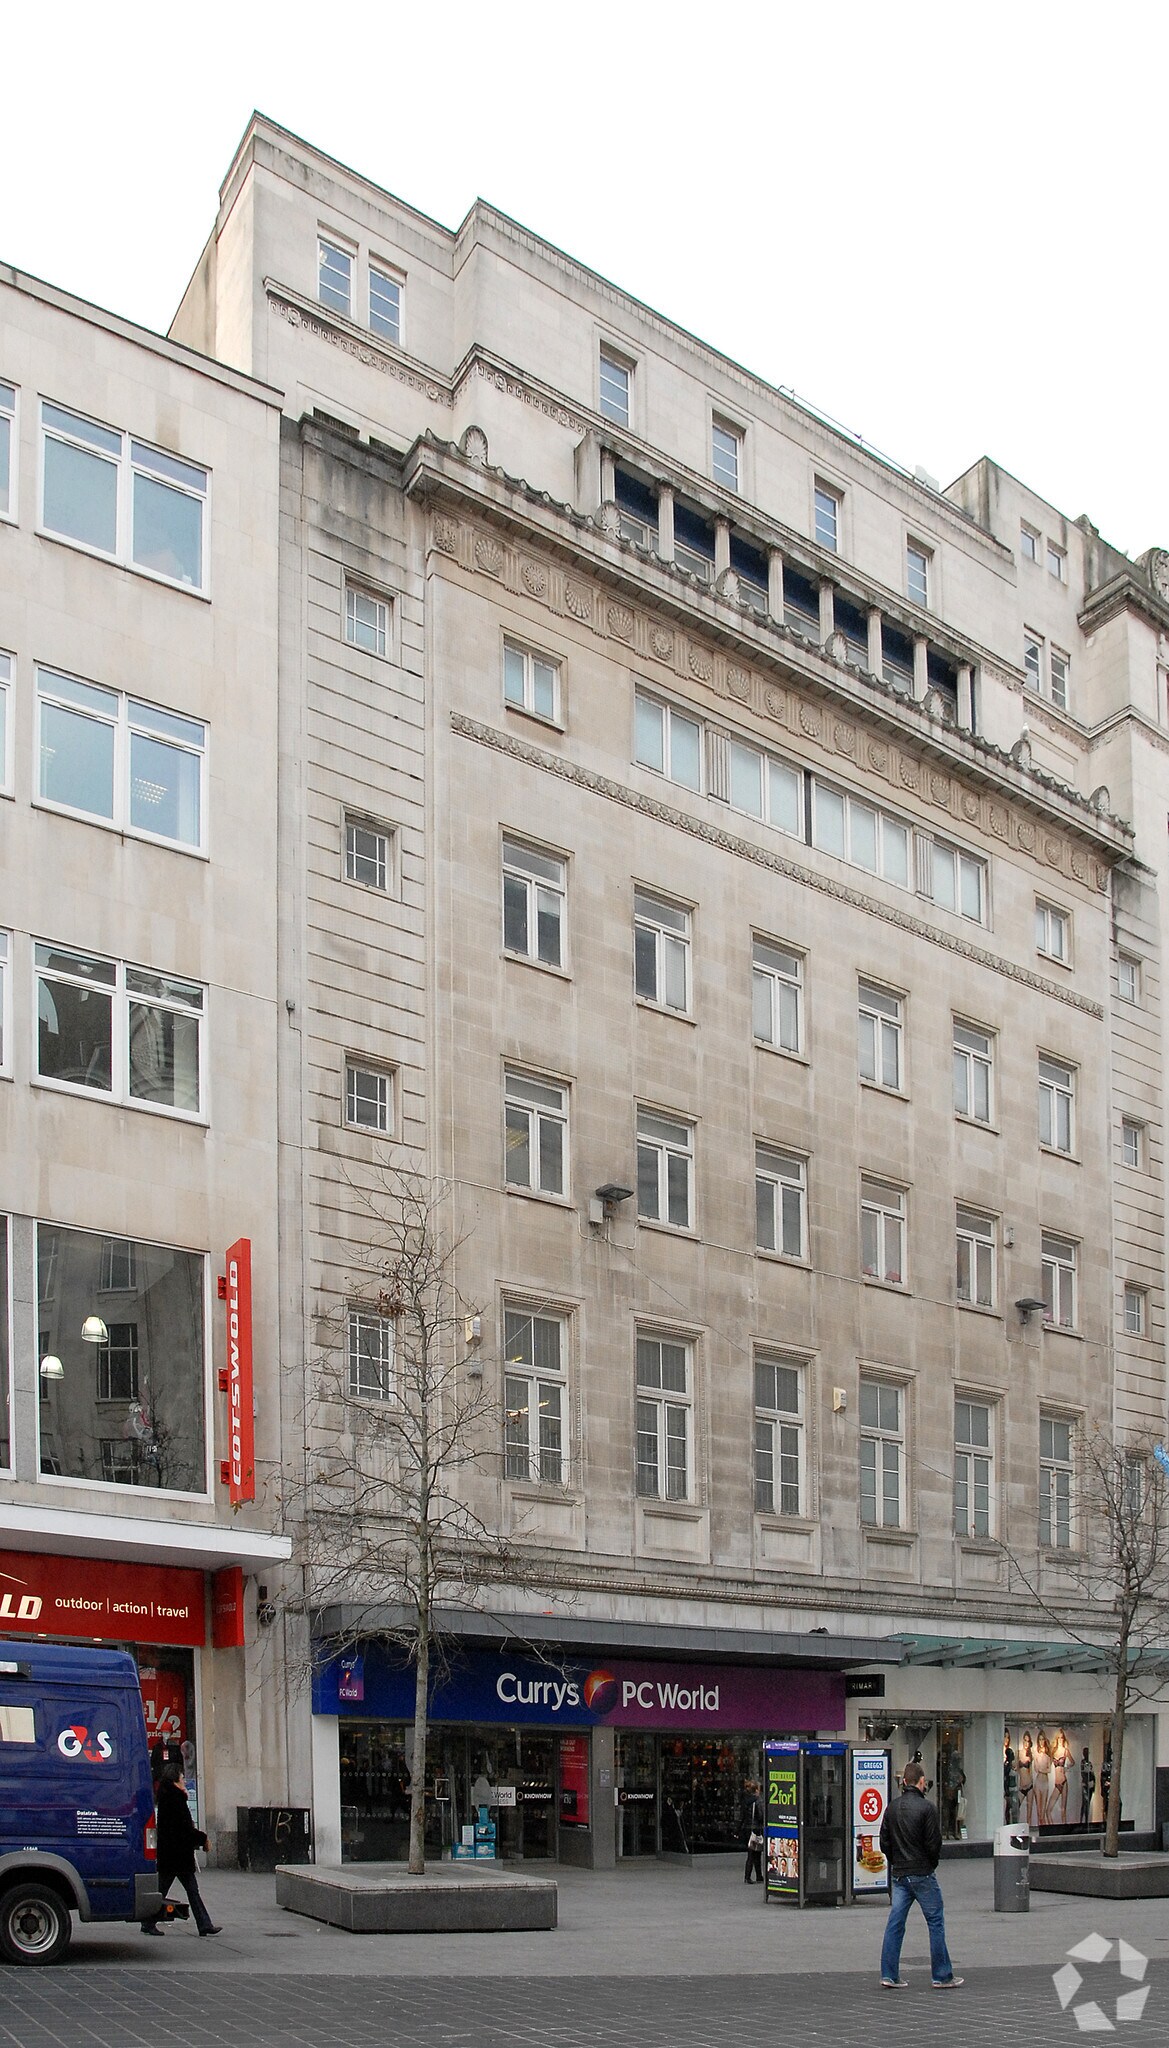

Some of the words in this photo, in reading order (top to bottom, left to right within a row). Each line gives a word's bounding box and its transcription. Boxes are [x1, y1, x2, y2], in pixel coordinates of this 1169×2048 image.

[229, 1260, 242, 1486] COTSWOLD
[55, 1597, 103, 1611] outdoor
[112, 1601, 148, 1615] action
[156, 1605, 189, 1618] travel
[496, 1672, 579, 1711] Currys
[622, 1681, 653, 1708] PC
[656, 1682, 719, 1711] World
[57, 1724, 113, 1763] G4S
[863, 1761, 883, 1769] GREGGS
[863, 1797, 878, 1816] £3
